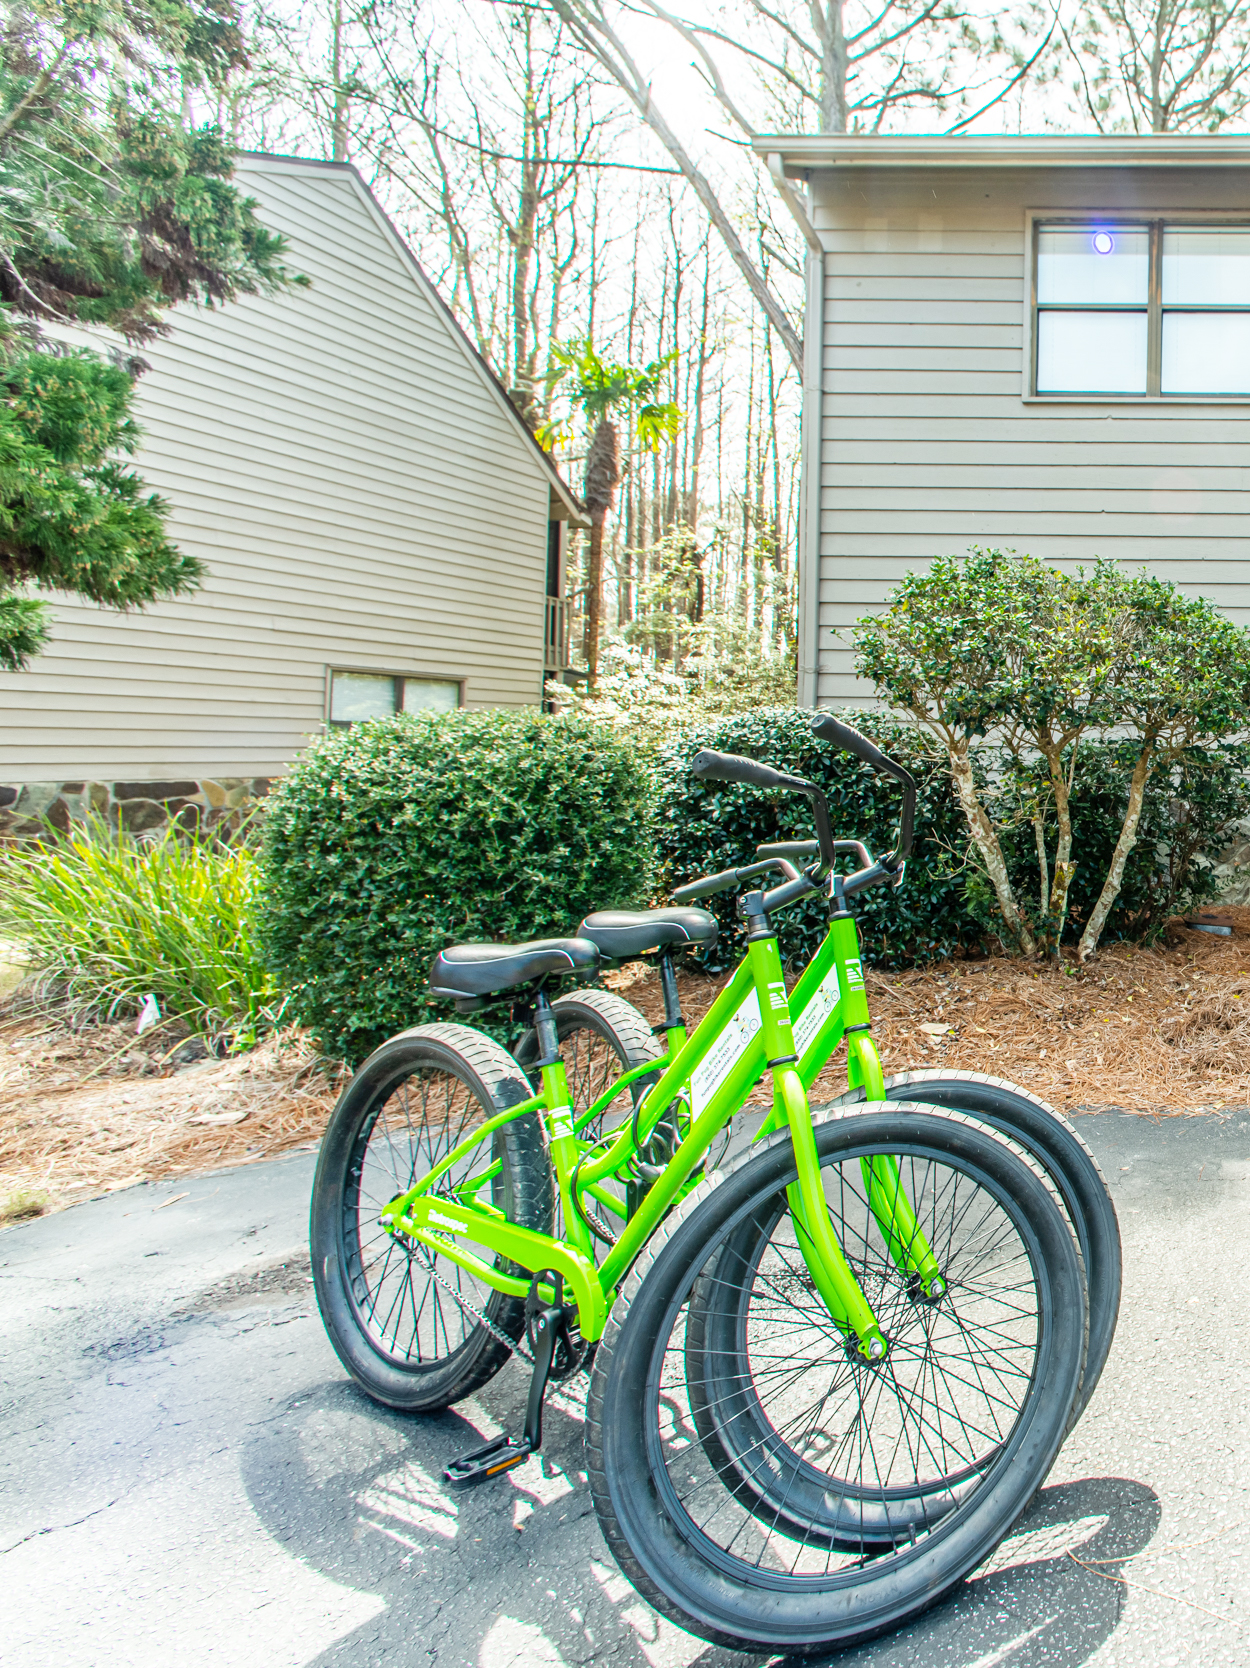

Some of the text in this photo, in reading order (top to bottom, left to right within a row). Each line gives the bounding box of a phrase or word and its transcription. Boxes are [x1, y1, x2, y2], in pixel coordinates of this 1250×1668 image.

[700, 1043, 741, 1097] funpugbikerentals.com
[707, 1053, 718, 1065] Bike
[716, 1032, 733, 1053] Rentals
